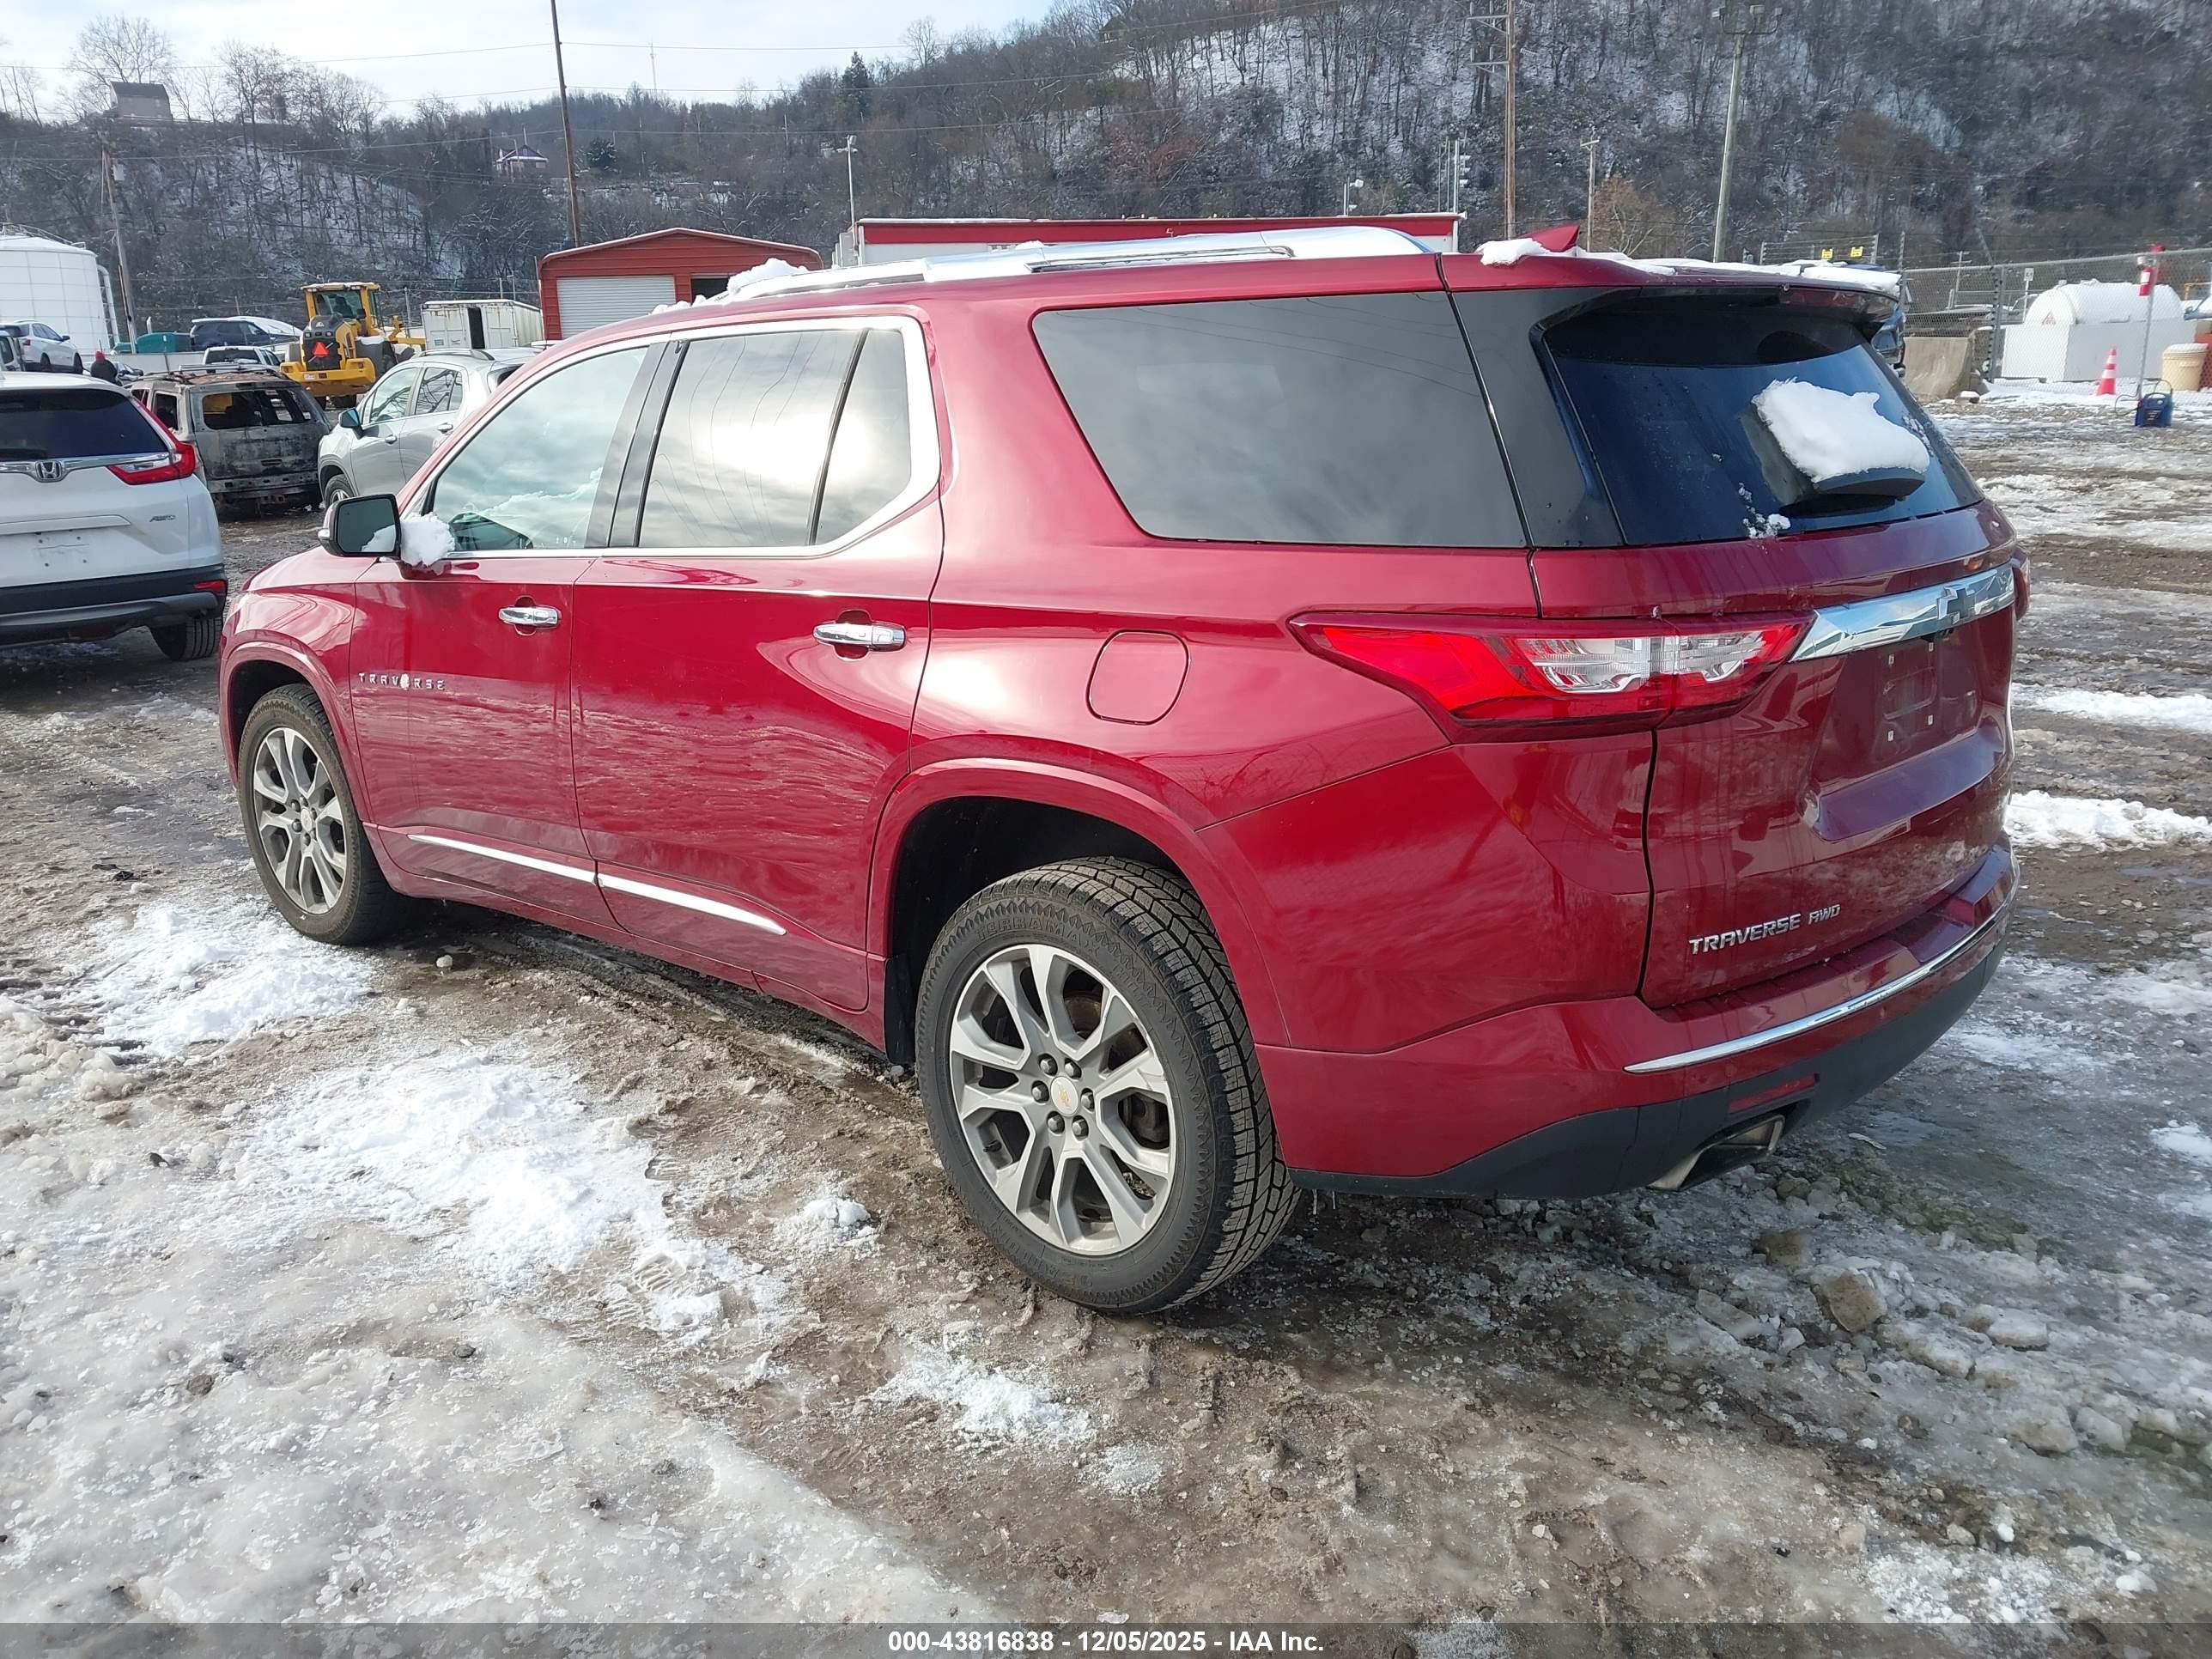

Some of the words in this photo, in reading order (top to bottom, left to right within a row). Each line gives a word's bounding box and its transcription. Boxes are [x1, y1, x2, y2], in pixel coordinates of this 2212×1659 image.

[358, 672, 446, 691] TRAVRSE
[1688, 913, 1802, 955] TRAVERSE
[1808, 903, 1841, 925] AWD
